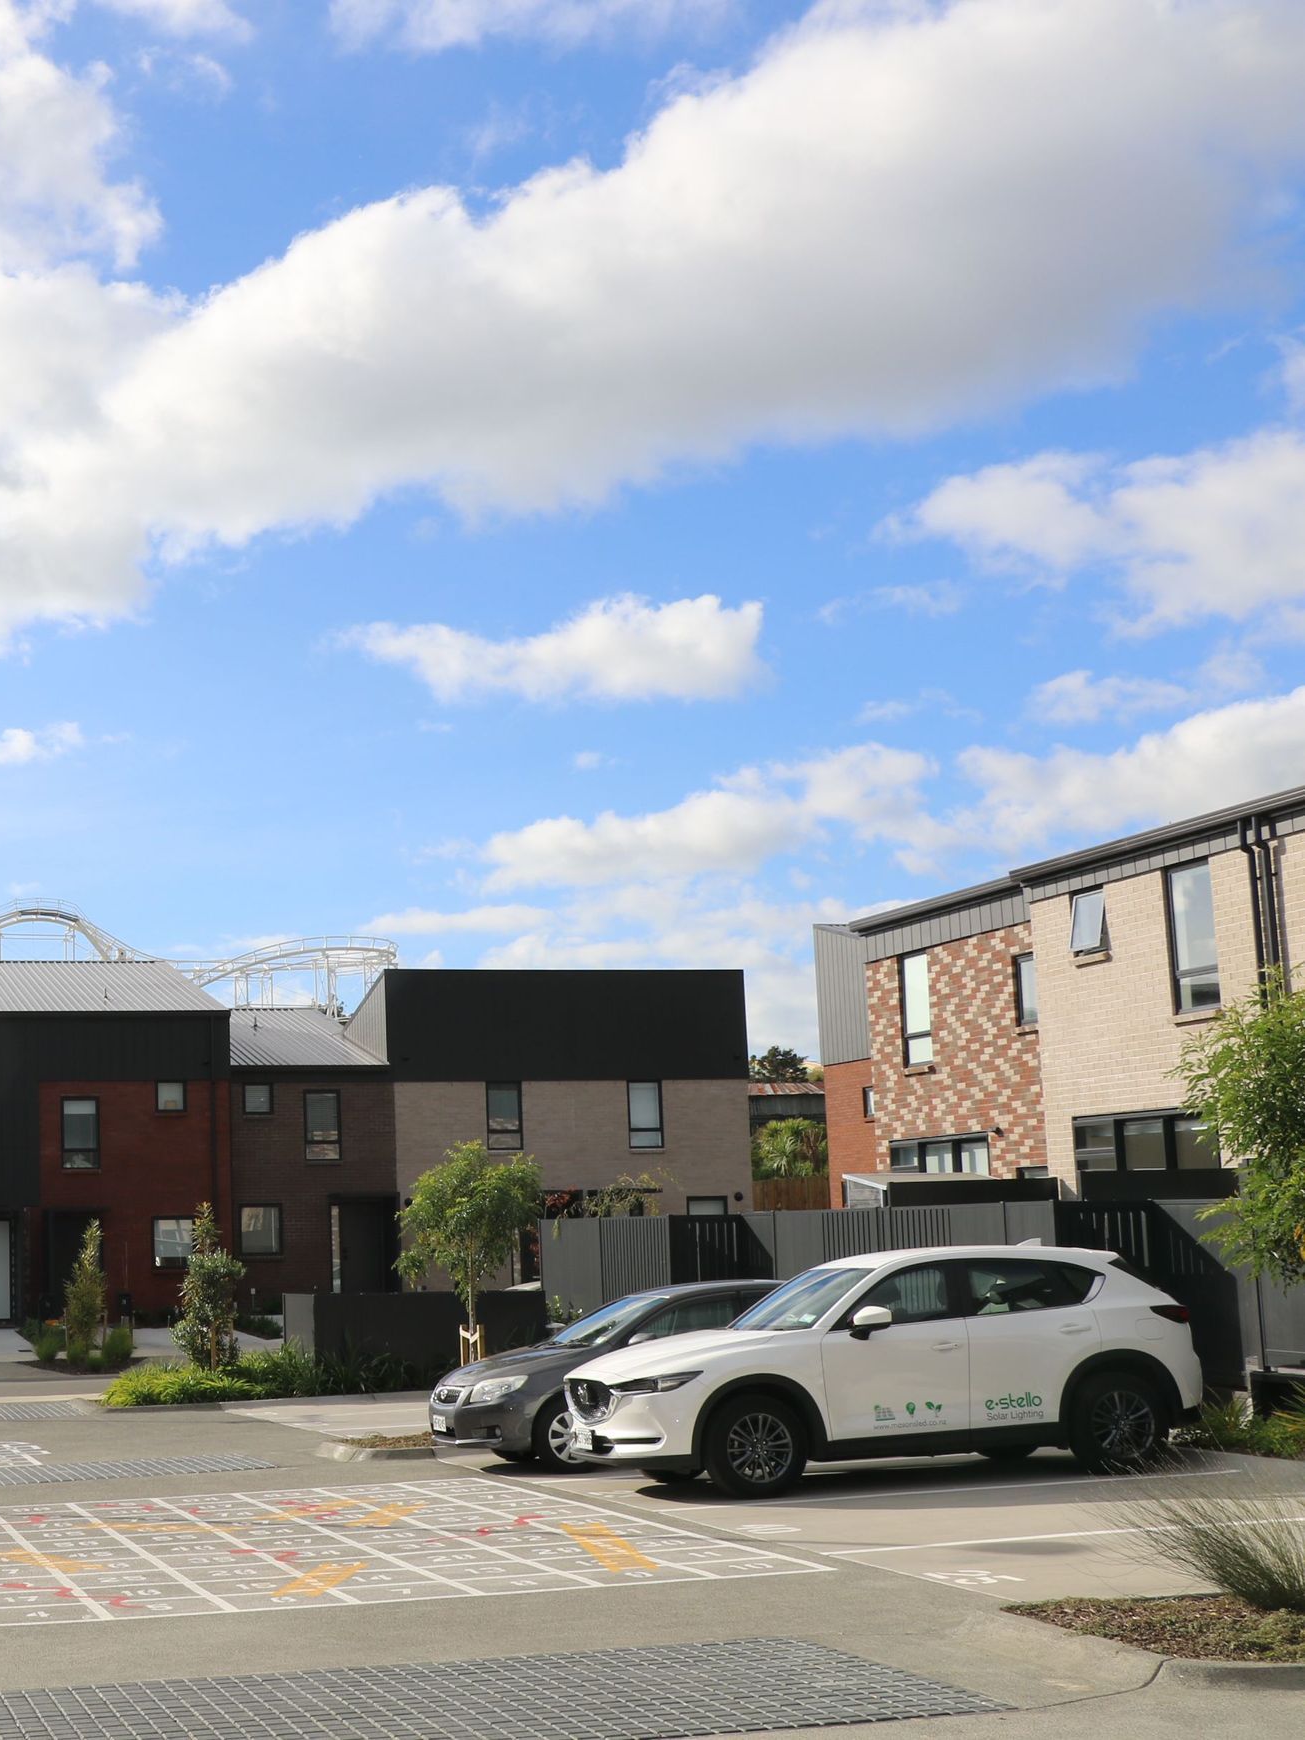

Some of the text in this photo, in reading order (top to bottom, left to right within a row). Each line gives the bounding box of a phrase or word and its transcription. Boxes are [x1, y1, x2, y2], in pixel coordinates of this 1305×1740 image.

[986, 1409, 1044, 1422] Solar Lighting
[921, 1569, 1027, 1584] 25
